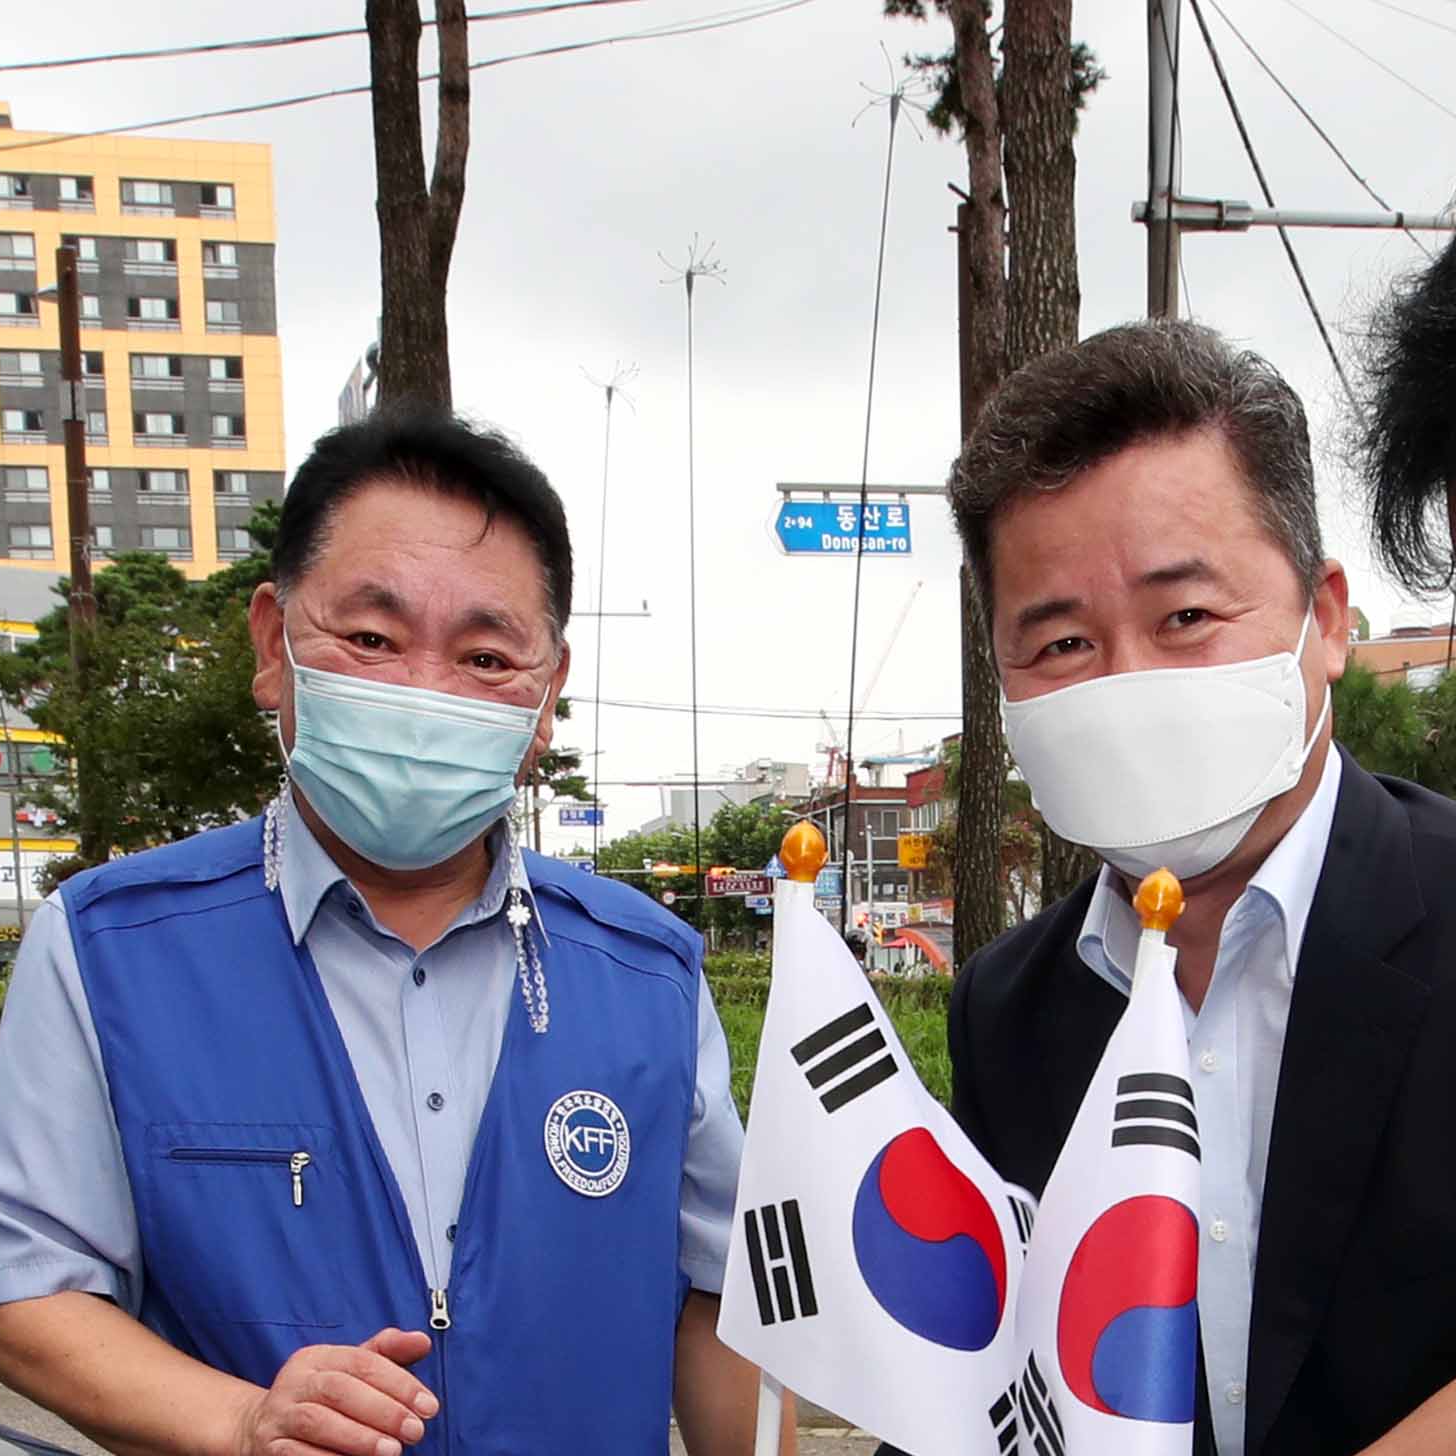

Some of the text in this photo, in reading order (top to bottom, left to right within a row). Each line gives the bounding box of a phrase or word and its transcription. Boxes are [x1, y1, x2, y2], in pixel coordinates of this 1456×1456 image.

[836, 505, 906, 532] 동산로
[821, 533, 907, 553] Dongsan-ro
[564, 1125, 615, 1155] KFF
[549, 1121, 563, 1161] KOREA
[558, 1160, 602, 1191] FREEDOM
